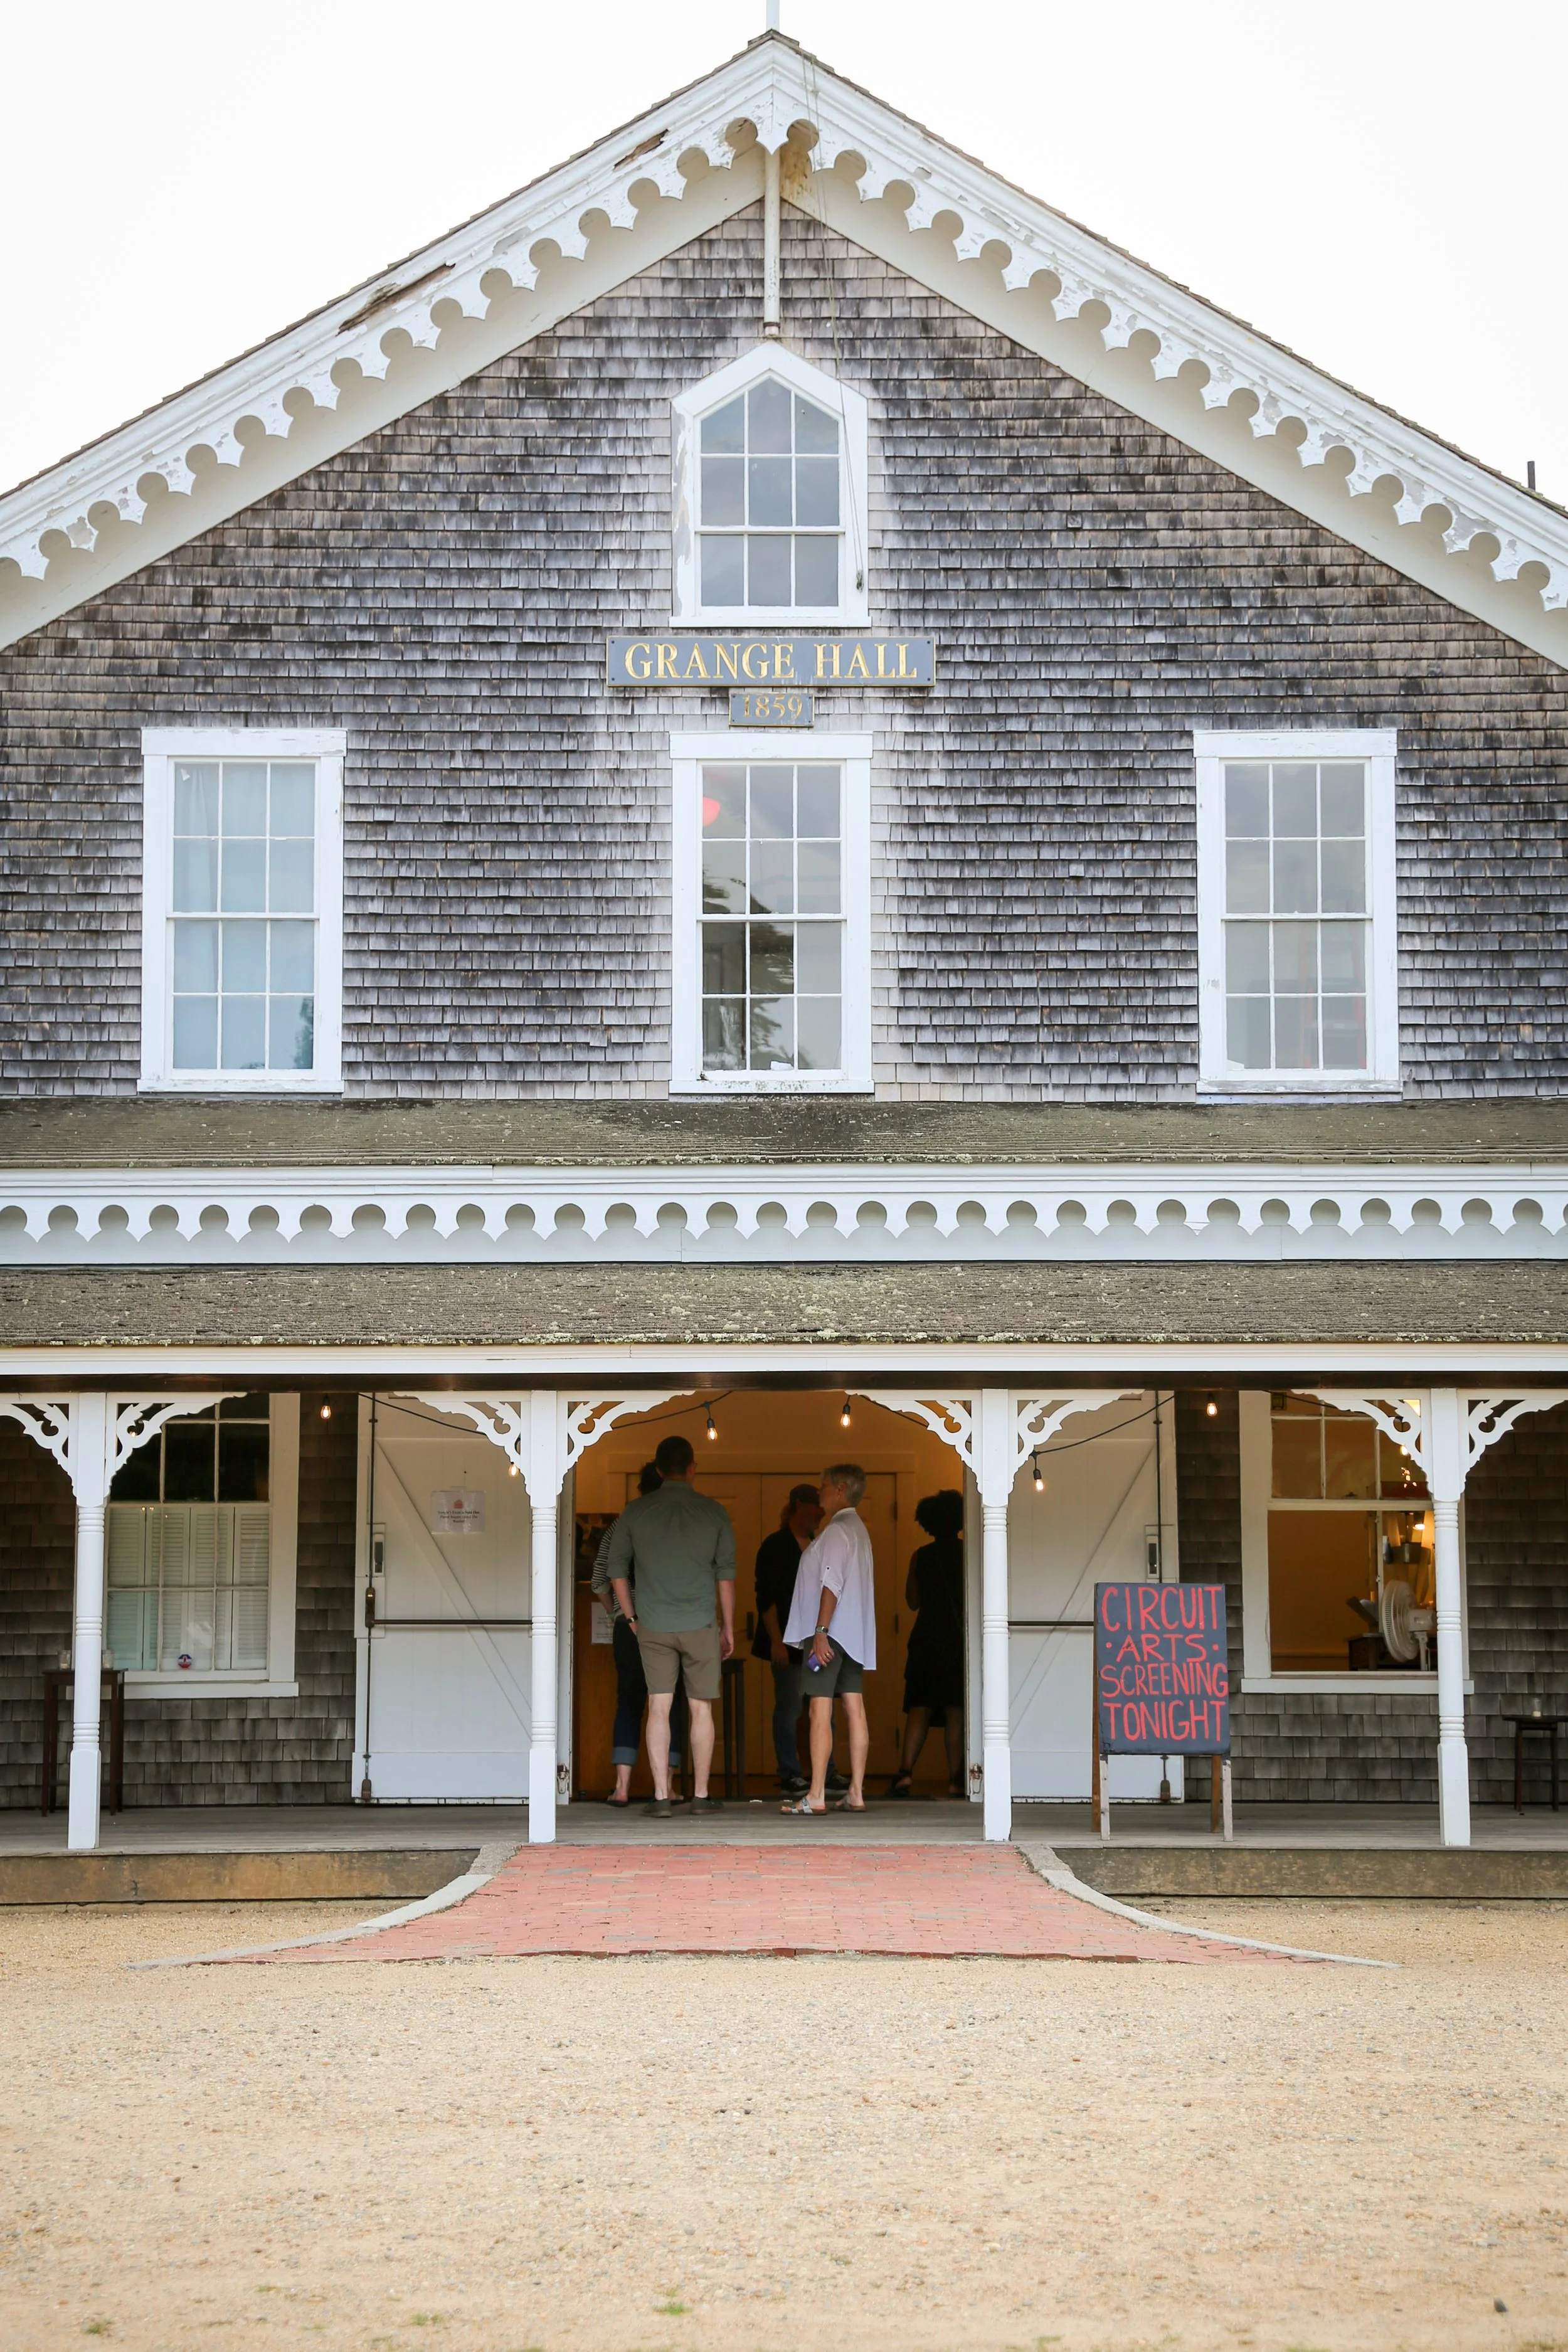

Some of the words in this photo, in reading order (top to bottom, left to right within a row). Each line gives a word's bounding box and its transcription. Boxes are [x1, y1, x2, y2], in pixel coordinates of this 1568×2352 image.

[625, 642, 795, 679] GRANGE
[813, 643, 917, 679] HALL
[743, 694, 802, 719] 1859
[1101, 1586, 1222, 1631] CIRCUIT
[1099, 1662, 1228, 1698] SCREENING
[1103, 1699, 1226, 1742] TONIGHT
